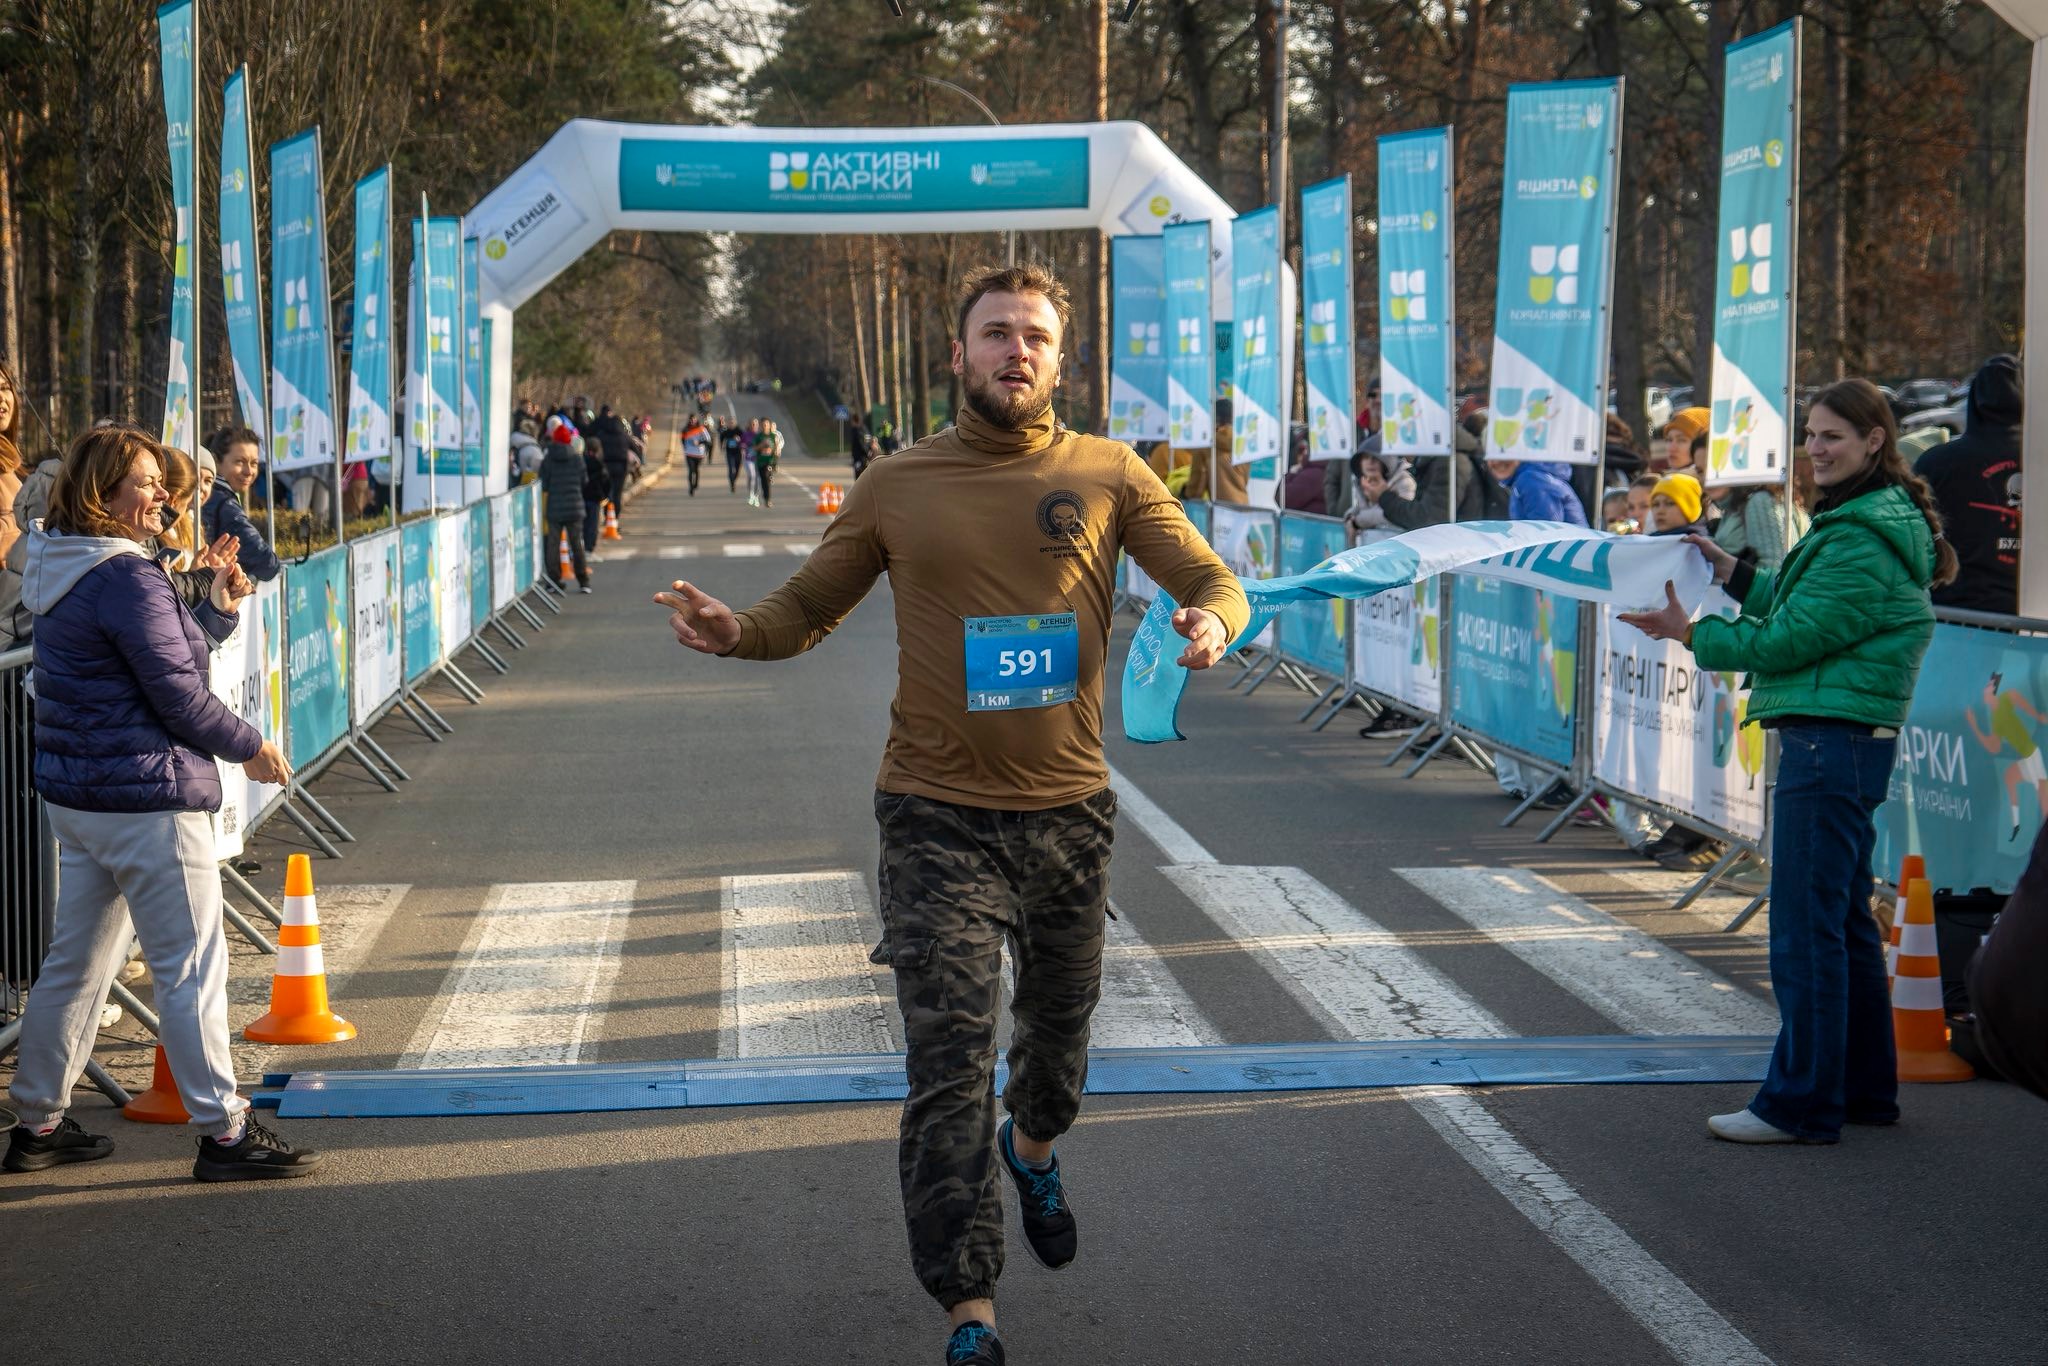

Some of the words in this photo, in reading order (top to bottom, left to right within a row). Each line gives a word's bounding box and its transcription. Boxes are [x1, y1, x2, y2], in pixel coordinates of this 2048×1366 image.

[812, 151, 940, 170] АКТИВНІ
[812, 171, 913, 190] ПАРКИ
[503, 191, 557, 242] АГЕНЦІЯ
[1040, 616, 1072, 626] АГЕНЦІЯ
[999, 648, 1052, 677] 591
